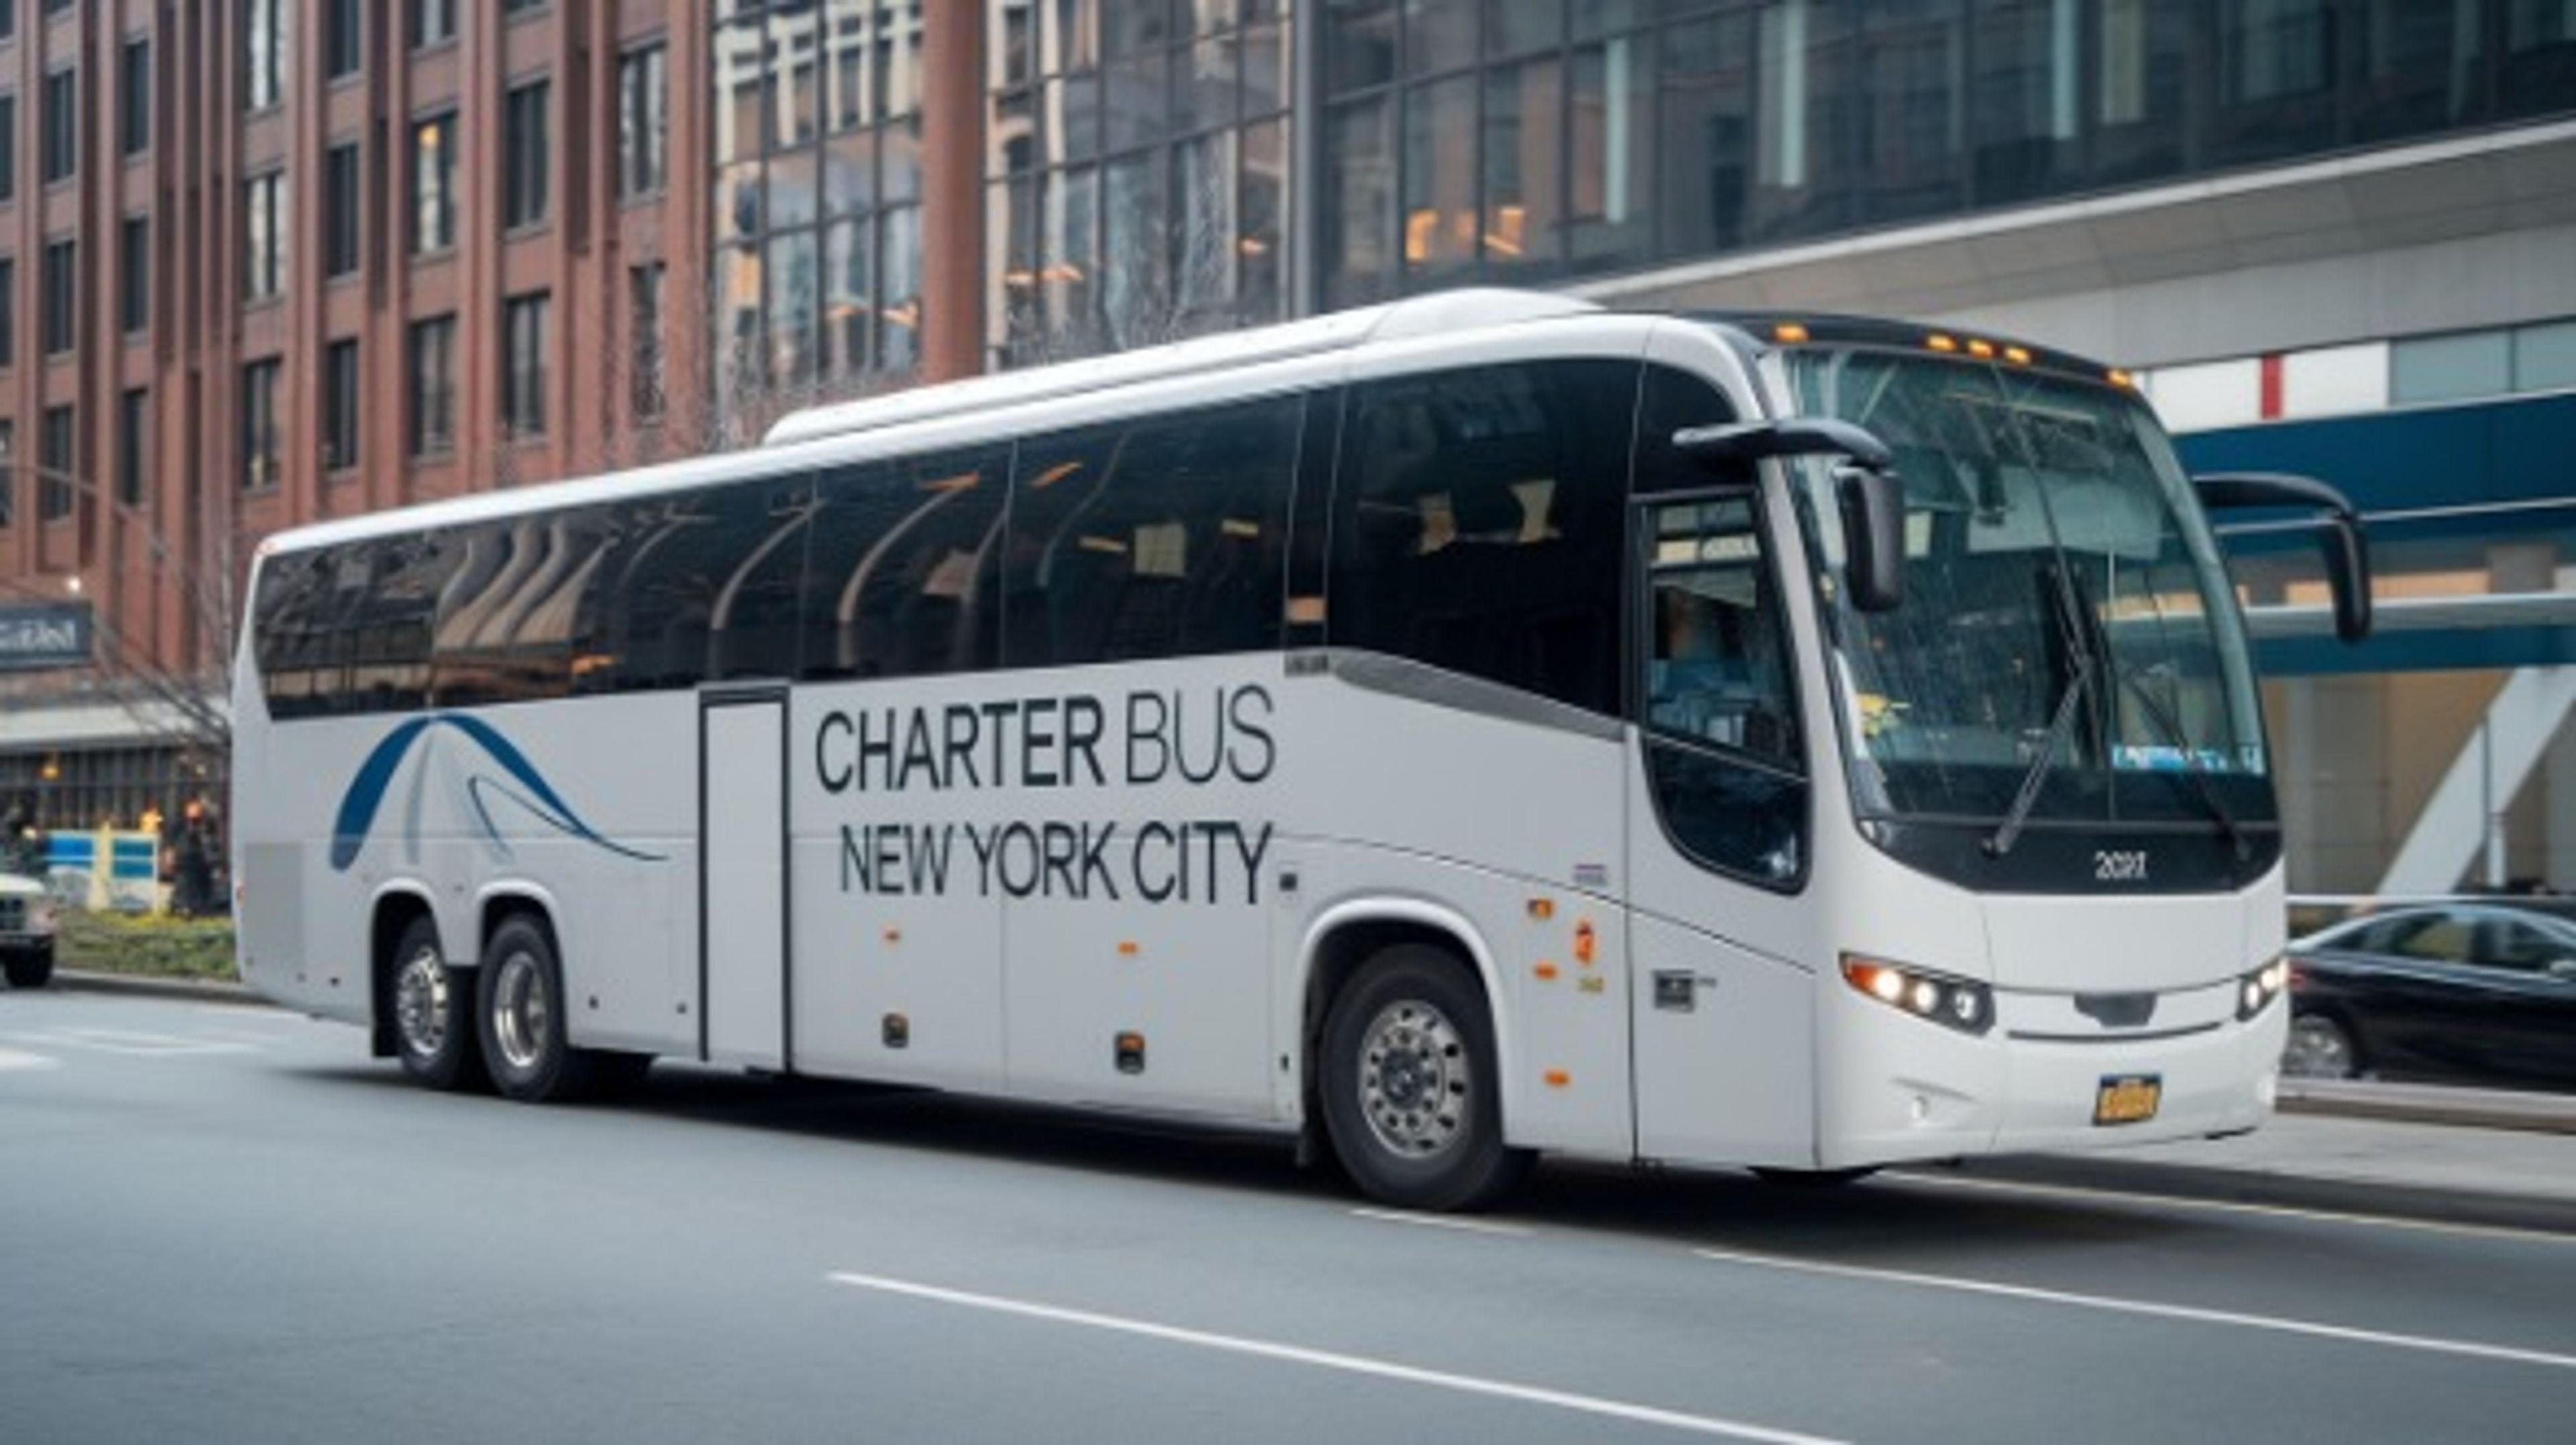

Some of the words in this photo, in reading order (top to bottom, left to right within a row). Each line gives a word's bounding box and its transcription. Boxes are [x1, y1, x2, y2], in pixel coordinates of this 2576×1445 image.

[816, 694, 1106, 794] CHARTER
[1126, 684, 1276, 784] BUS
[841, 823, 954, 896] NEW
[965, 820, 1119, 900] YORK
[1132, 820, 1273, 905] CITY
